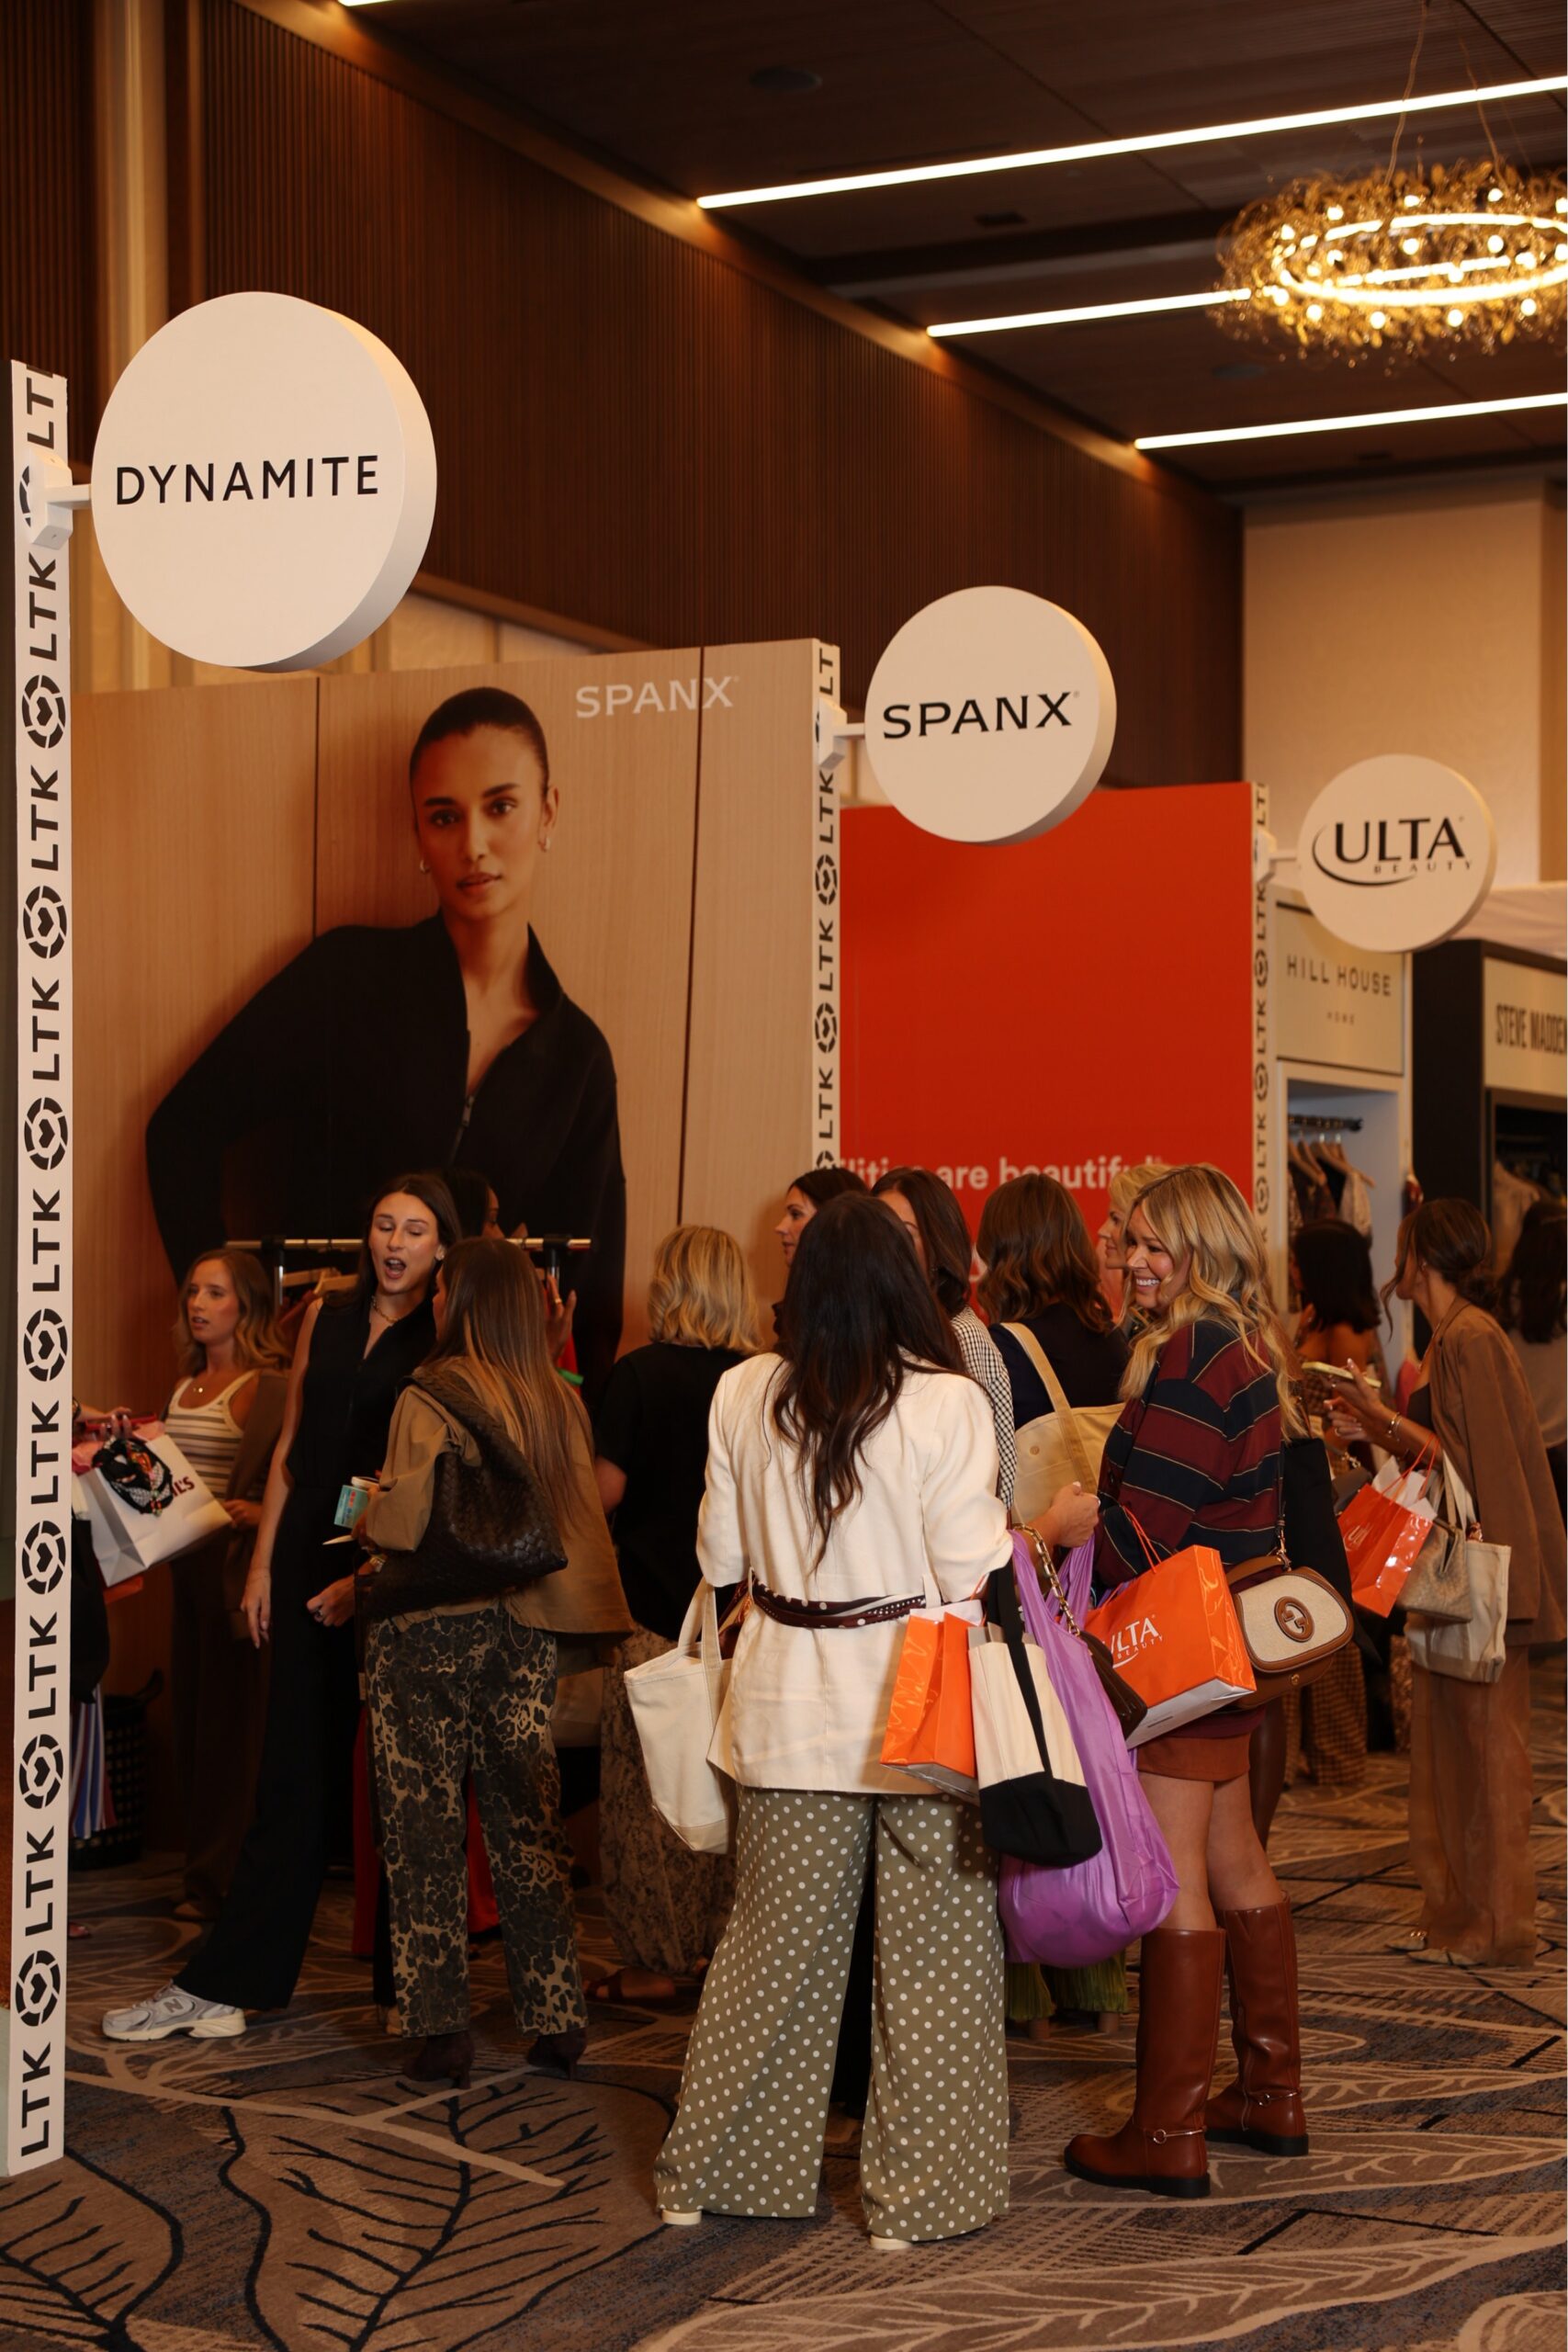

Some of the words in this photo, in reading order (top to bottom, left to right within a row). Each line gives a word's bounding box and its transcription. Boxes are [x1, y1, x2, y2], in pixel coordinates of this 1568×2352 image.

[26, 365, 54, 450] LT
[117, 455, 378, 505] DYNAMITE
[28, 552, 58, 662] LTK
[575, 676, 733, 719] SPANX
[883, 692, 1073, 740] SPANX
[30, 763, 60, 872] LTK
[818, 769, 834, 844] LTK
[1256, 783, 1266, 827] LT
[1335, 817, 1465, 864] ULTA
[1373, 860, 1472, 873] BEAUTY
[1256, 882, 1266, 940] LTK
[818, 919, 834, 992] LTK
[1287, 954, 1329, 983] HILL
[1337, 965, 1391, 997] HOUSE
[31, 977, 60, 1081] LTK
[1257, 999, 1267, 1055] LTK
[1495, 1003, 1527, 1049] STEVE
[818, 1067, 834, 1139] LTK
[1257, 1113, 1267, 1169] LTK
[935, 1165, 989, 1190] are
[32, 1189, 61, 1293] LTK
[30, 1400, 60, 1505] LTK
[28, 1611, 58, 1720] LTK
[25, 1826, 55, 1938] LTK
[20, 2041, 52, 2157] LTK
